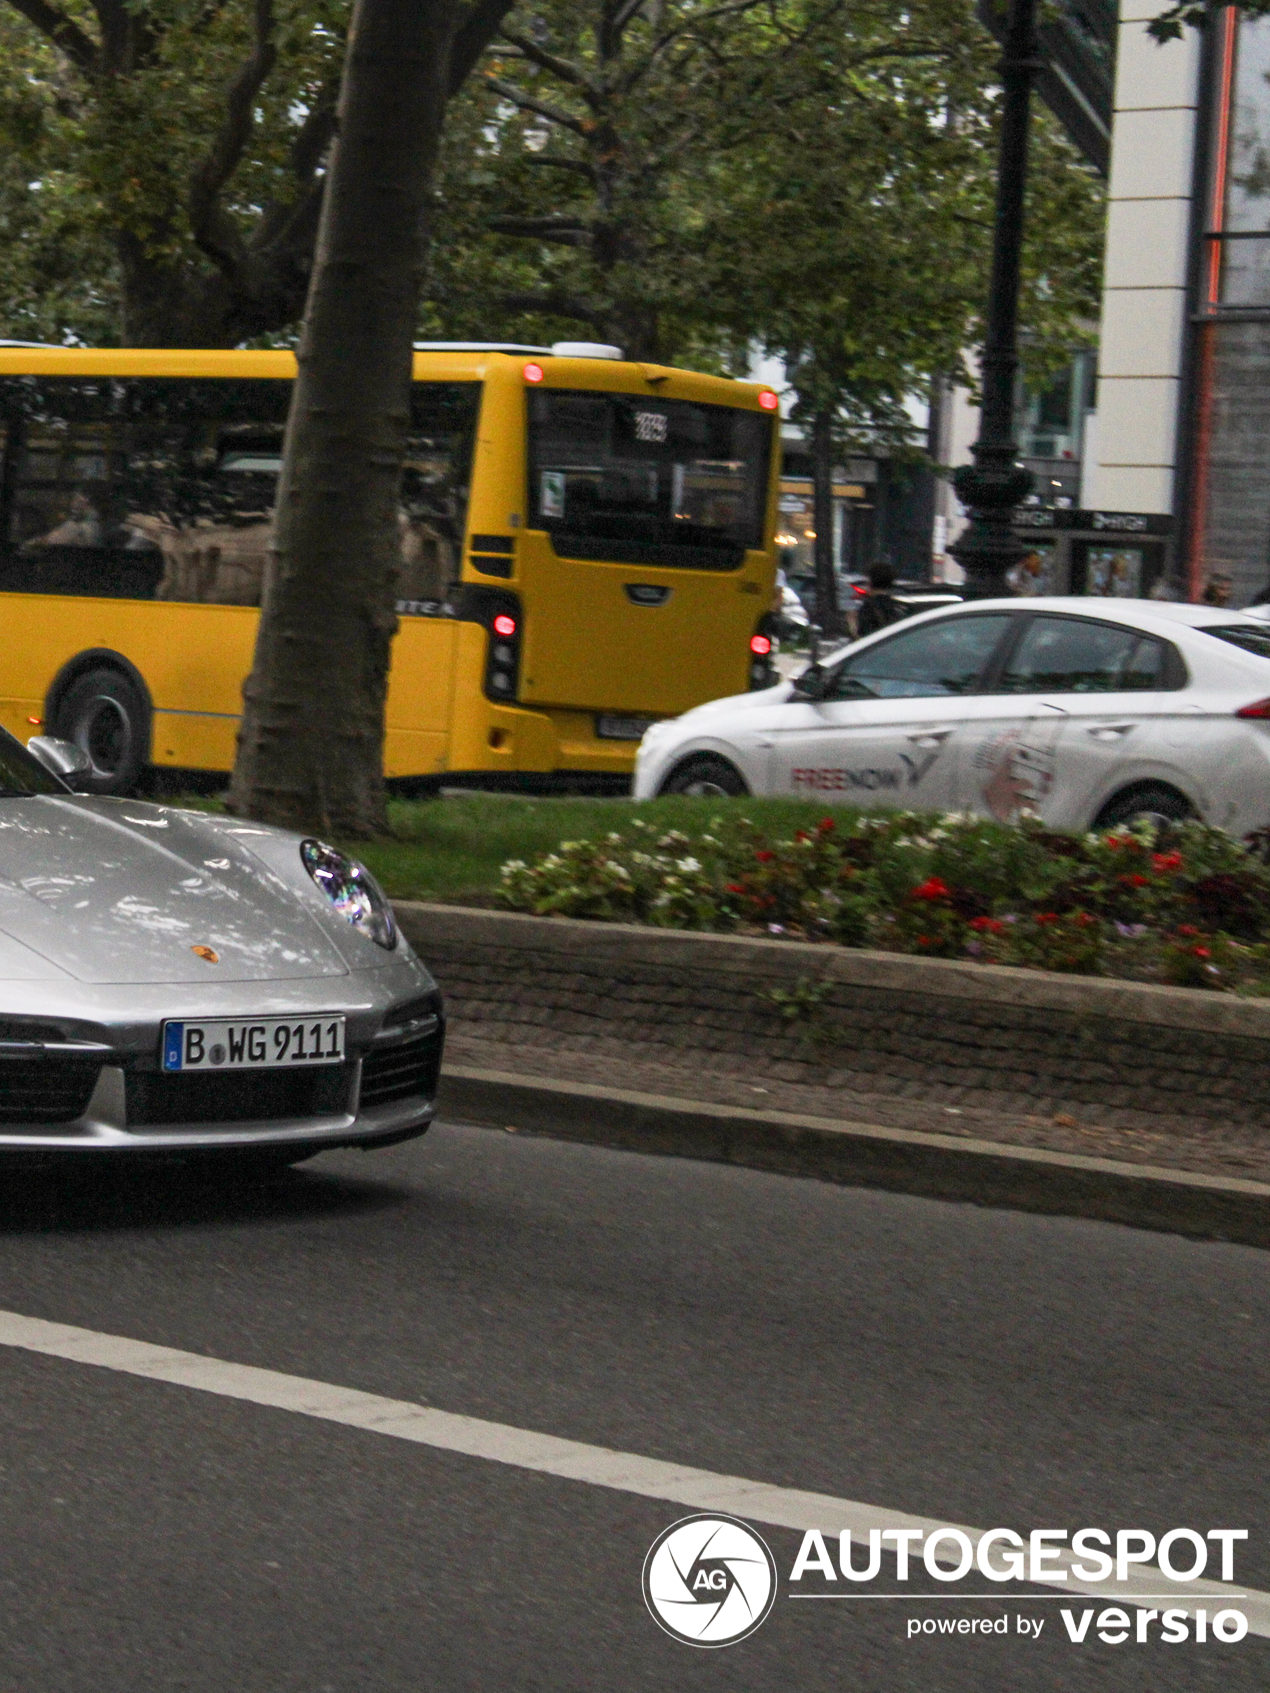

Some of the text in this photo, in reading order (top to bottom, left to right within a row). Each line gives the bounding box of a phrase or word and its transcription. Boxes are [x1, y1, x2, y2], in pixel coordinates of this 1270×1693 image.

[186, 1022, 341, 1064] B WG 9111
